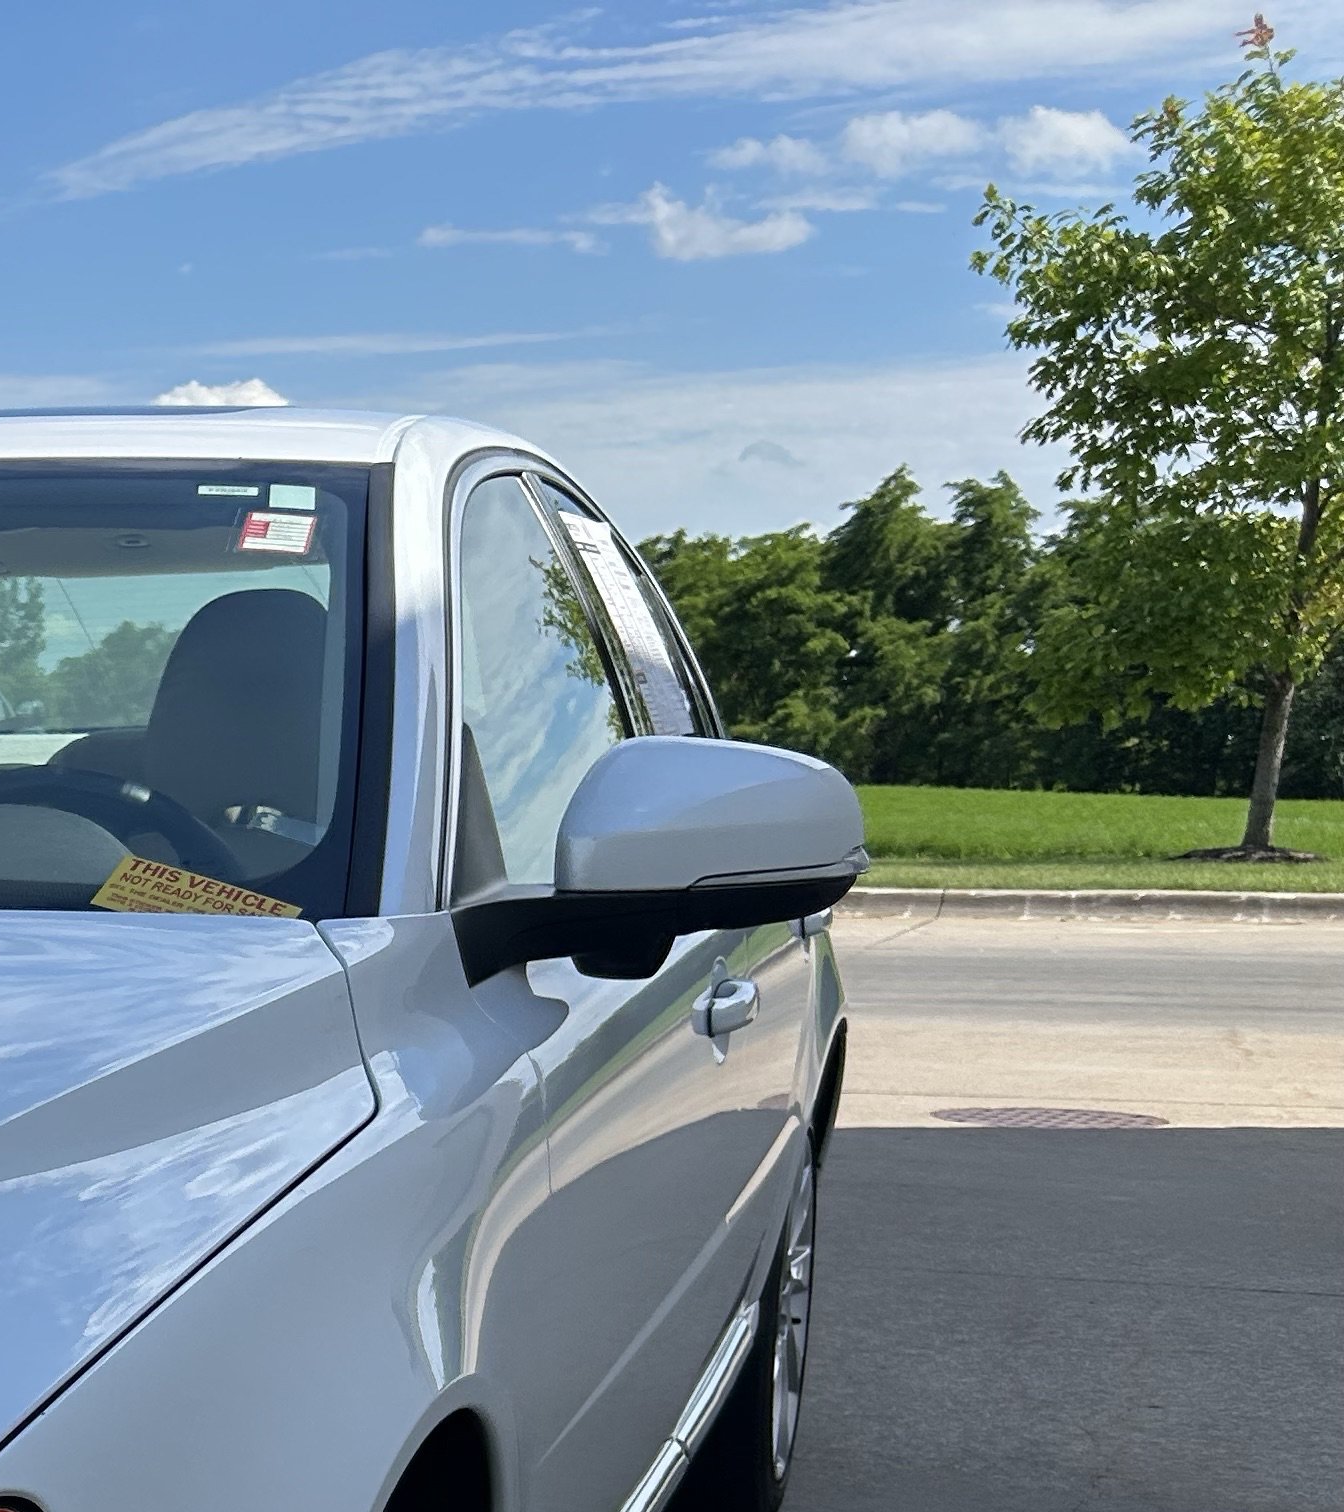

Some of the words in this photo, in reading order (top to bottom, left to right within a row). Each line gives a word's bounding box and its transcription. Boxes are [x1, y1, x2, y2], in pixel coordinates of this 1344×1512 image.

[119, 872, 152, 888] NOT
[151, 881, 203, 902] READY
[202, 896, 234, 913] FOR
[130, 858, 182, 883] THIS
[188, 875, 288, 916] VEHICLE
